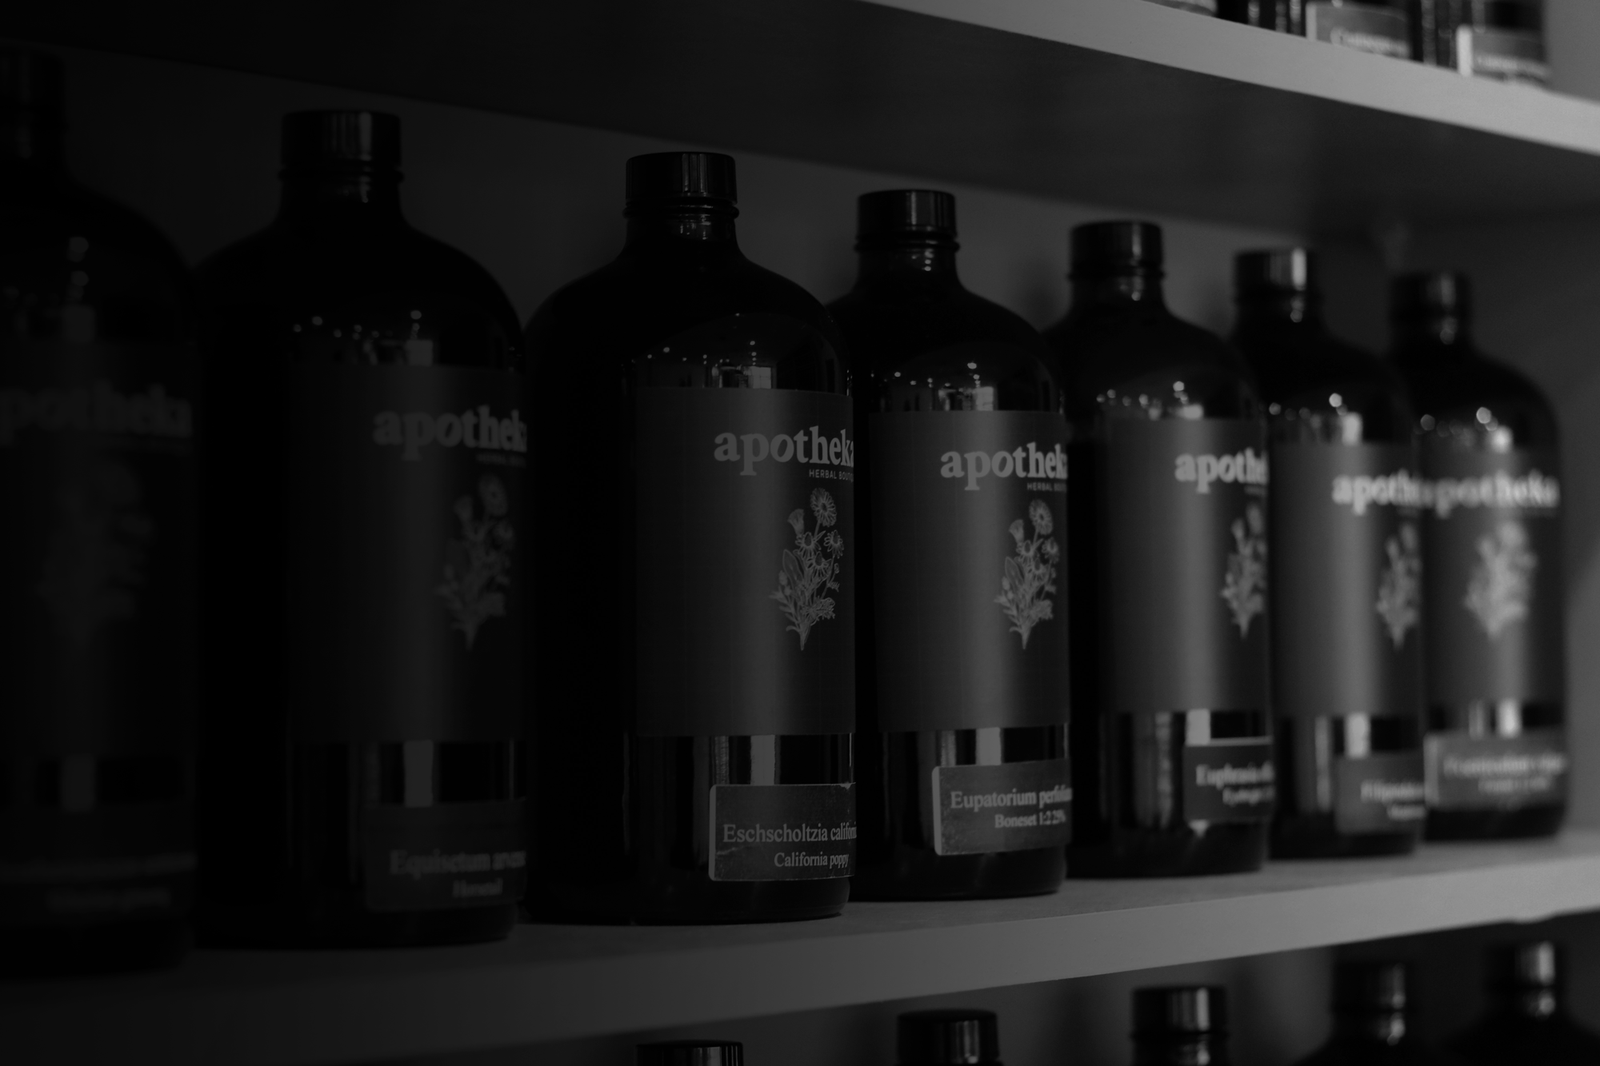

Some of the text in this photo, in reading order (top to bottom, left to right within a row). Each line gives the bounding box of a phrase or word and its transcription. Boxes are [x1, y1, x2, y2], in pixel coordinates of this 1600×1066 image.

[809, 469, 837, 480] HERBAL
[951, 788, 1037, 812] Eupatorium
[995, 814, 1038, 828] Boneset
[723, 823, 828, 843] Eschscholtzia
[774, 851, 850, 869] California poppy
